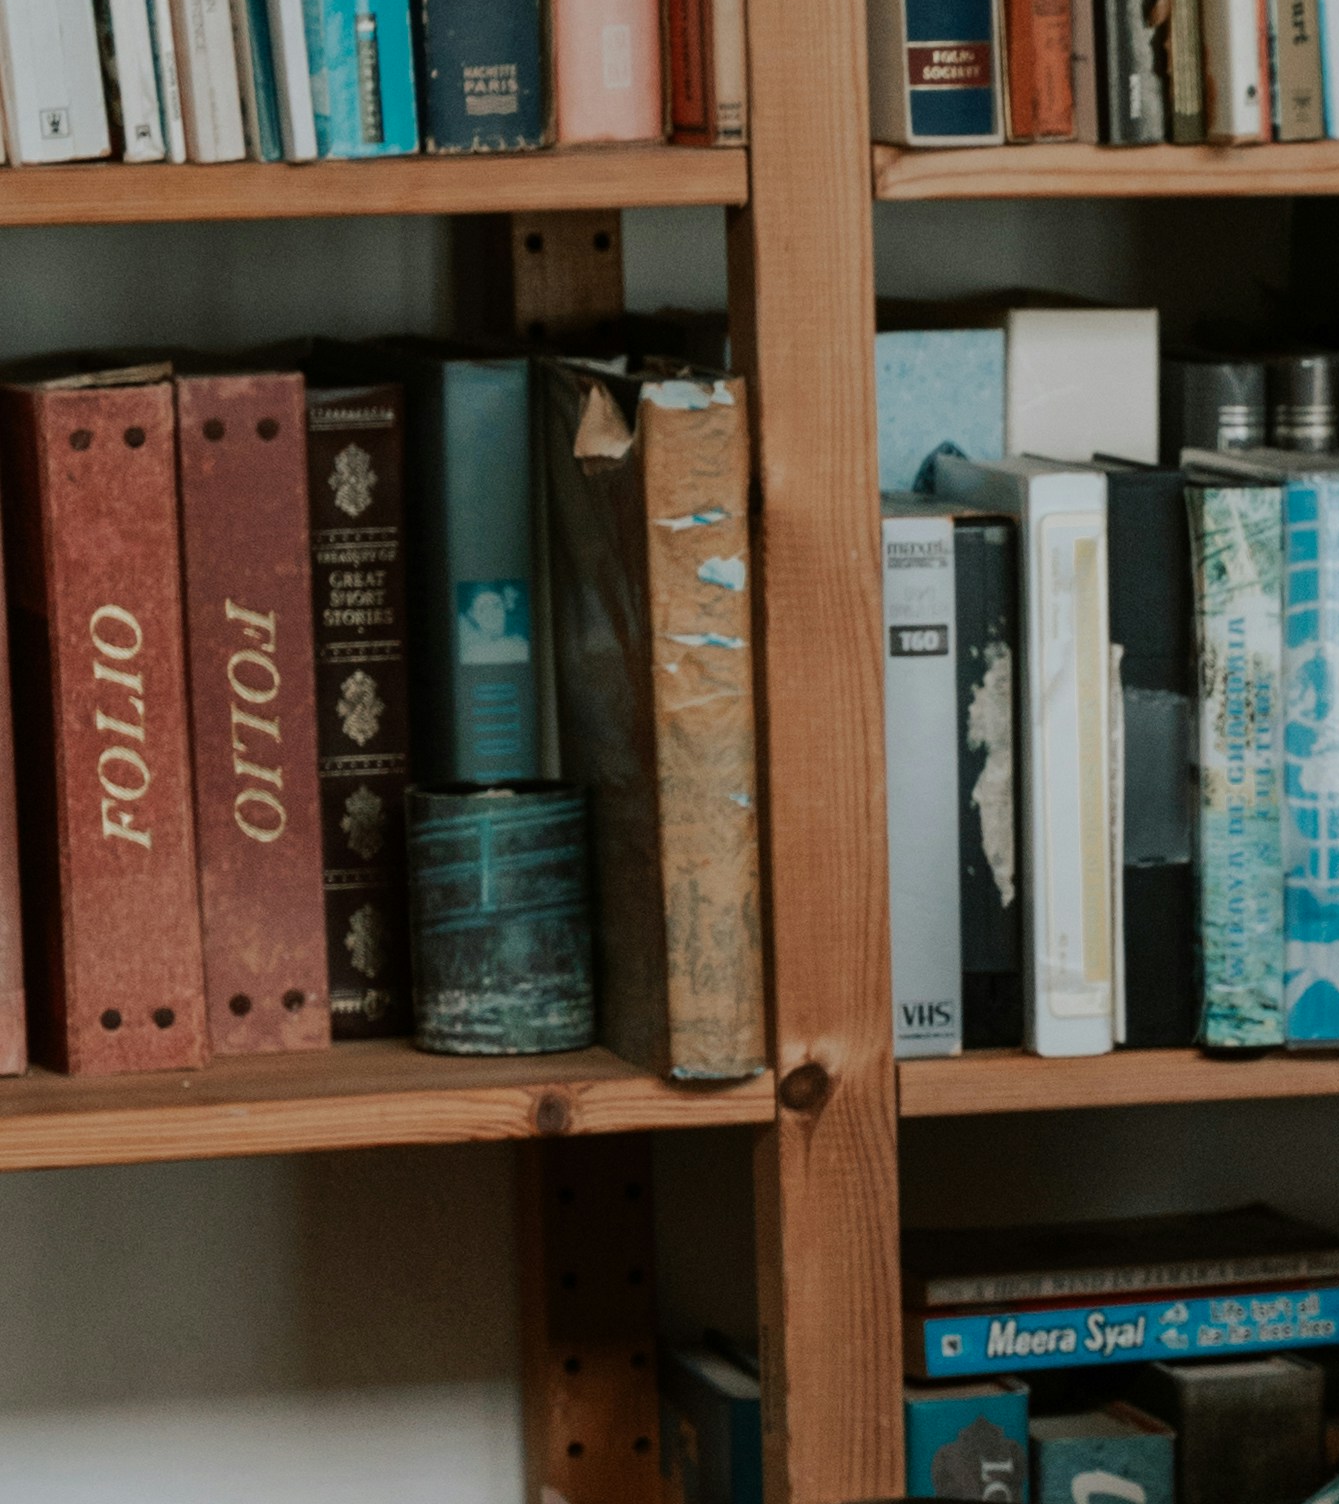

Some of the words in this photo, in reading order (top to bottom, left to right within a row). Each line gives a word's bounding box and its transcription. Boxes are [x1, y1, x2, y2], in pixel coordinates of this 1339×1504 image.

[463, 79, 520, 94] PARIS
[329, 569, 387, 588] GREAT
[329, 590, 386, 607] SHORT
[322, 609, 394, 627] STORIES
[89, 604, 153, 850] FOLIO
[225, 598, 287, 843] FOLIO
[902, 1000, 952, 1027] VHS
[1210, 1299, 1247, 1323] Life
[988, 1320, 1077, 1359] Meera
[1085, 1312, 1145, 1356] Syal
